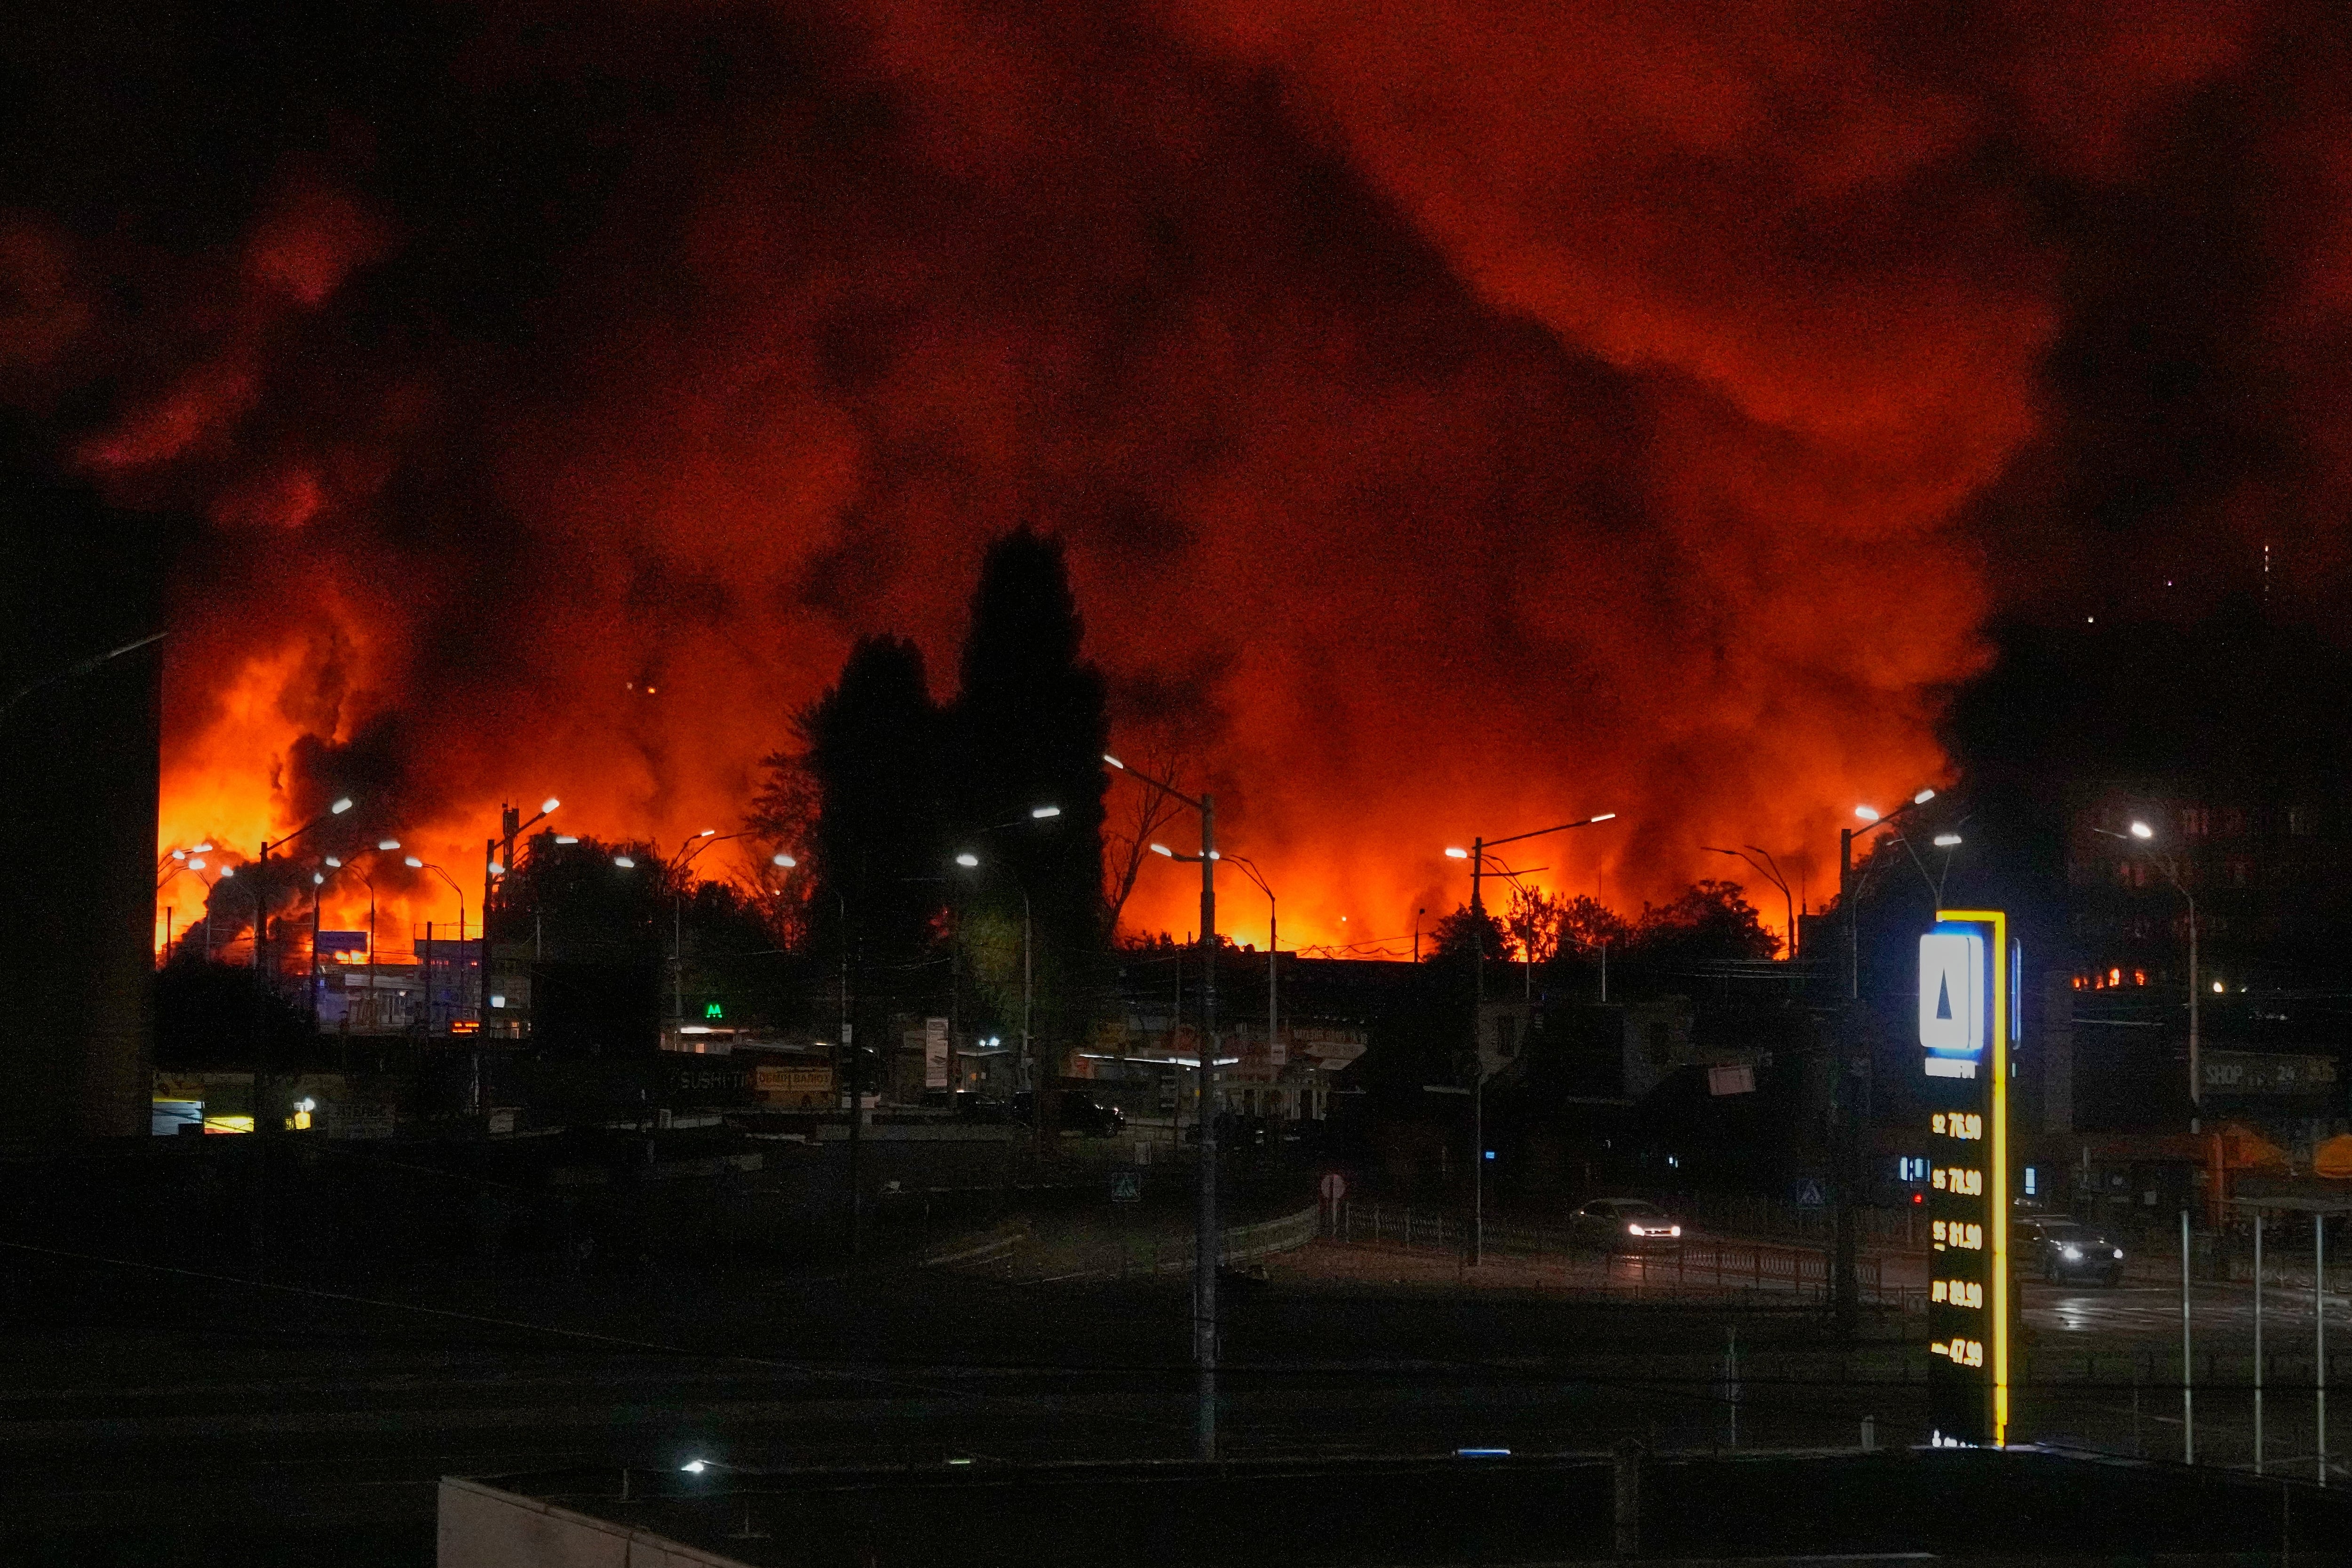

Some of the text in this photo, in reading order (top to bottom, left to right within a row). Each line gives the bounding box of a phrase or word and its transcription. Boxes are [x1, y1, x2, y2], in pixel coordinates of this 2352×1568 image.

[2205, 1065, 2243, 1085] SHOP
[1948, 1113, 1981, 1139] 76.90
[1933, 1168, 1981, 1195] 95 78.90
[1933, 1221, 1982, 1250] 95 81.90
[1949, 1280, 1982, 1308] 89.90
[1949, 1339, 1982, 1367] 47.99
